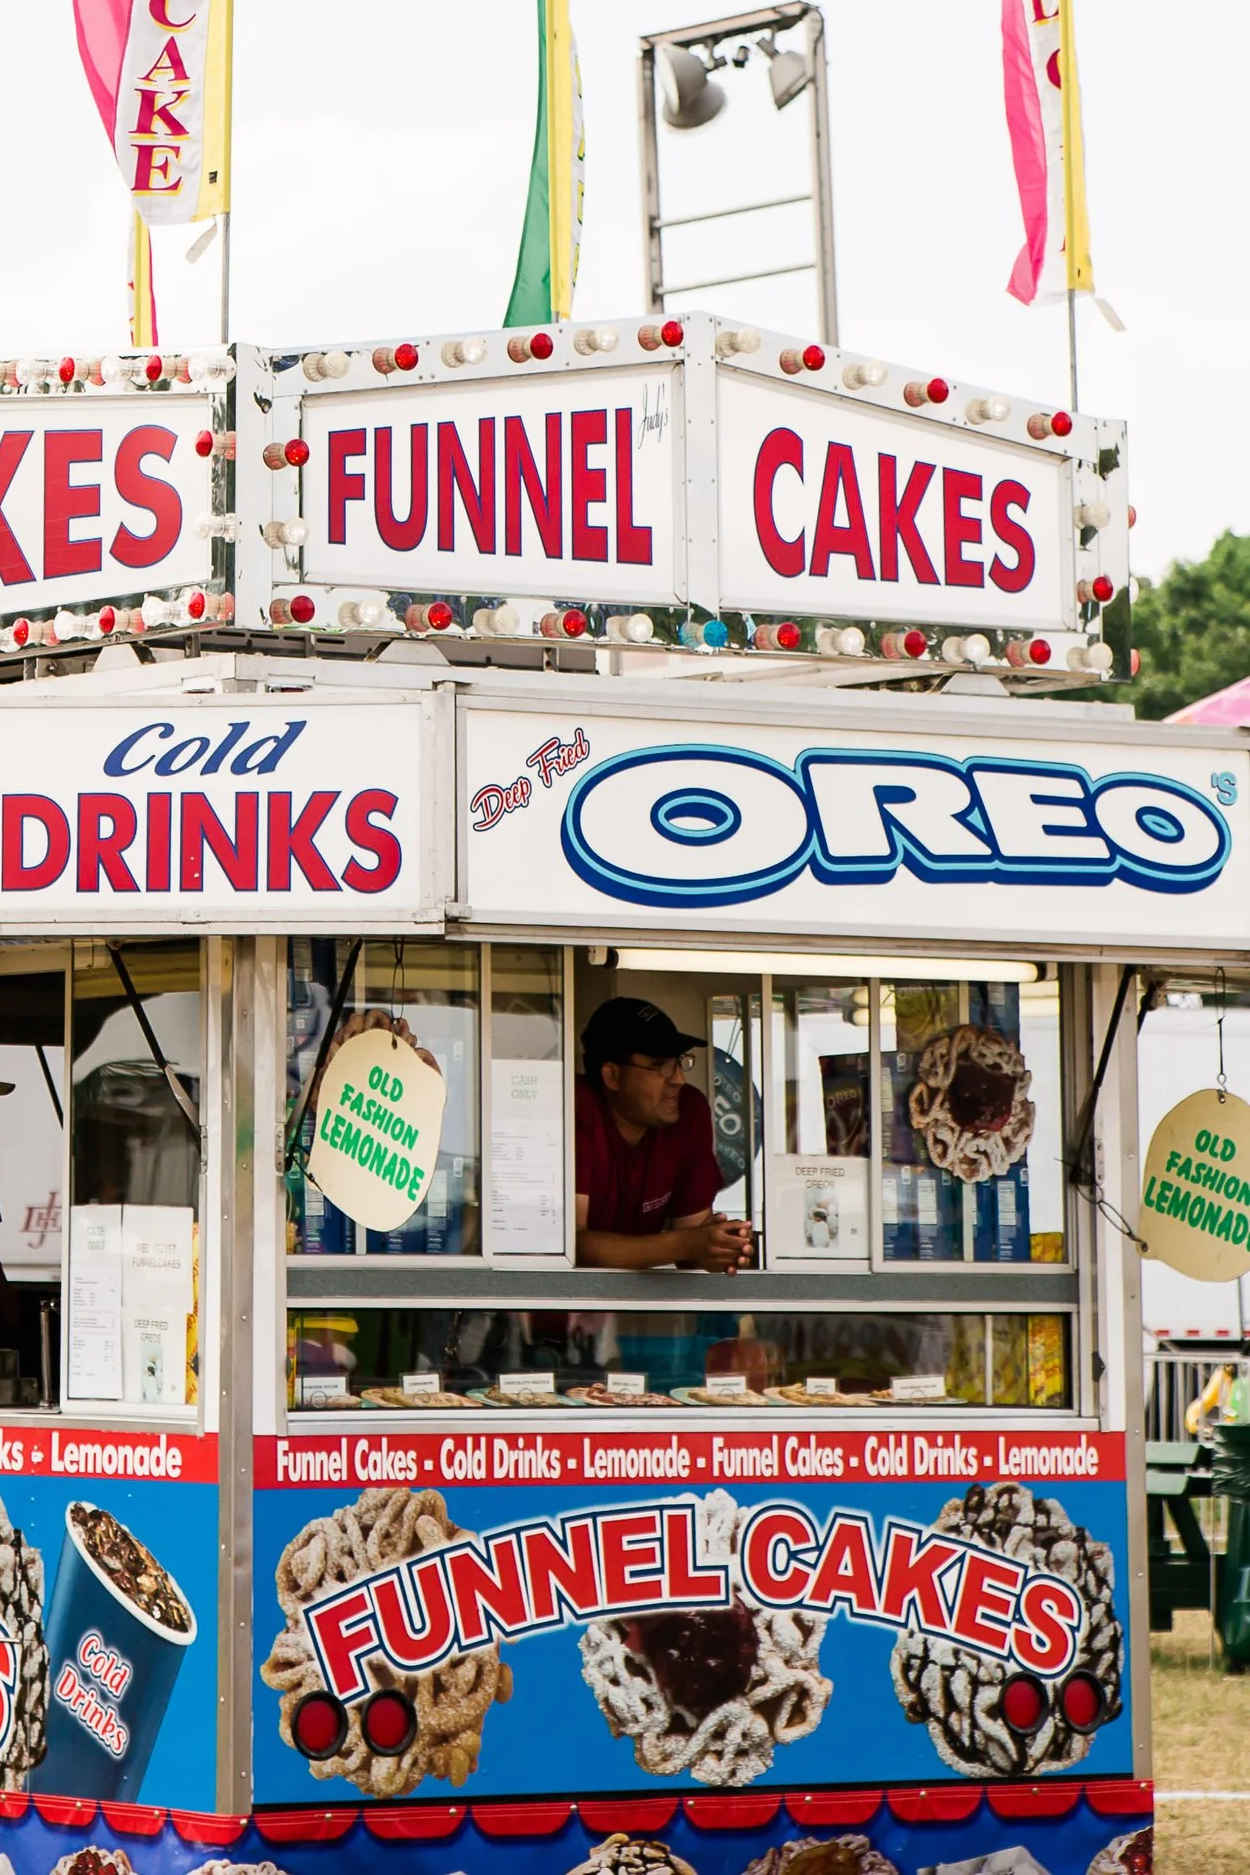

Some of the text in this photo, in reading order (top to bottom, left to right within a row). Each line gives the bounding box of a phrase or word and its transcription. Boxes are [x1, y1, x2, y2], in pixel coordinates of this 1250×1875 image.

[326, 406, 654, 566] FUNNEL
[753, 426, 1036, 593] CAKES
[100, 720, 311, 779] Cold
[470, 727, 590, 832] Deep Fried
[0, 789, 403, 894] DRINKS
[368, 1066, 404, 1102] OLD
[510, 1076, 538, 1086] CASH
[339, 1084, 419, 1151] FASHION
[1195, 1129, 1236, 1162] OLD
[319, 1108, 425, 1201] LEMONADE
[1144, 1176, 1250, 1252] LEMONAD
[51, 1431, 182, 1478] Lemonade
[277, 1434, 1099, 1483] Funnel Cakes Cold Drinks Lemonade Funnel Cakes Cold Drinks Lemonade
[306, 1505, 1079, 1700] FUNNEL CAKES
[80, 1634, 131, 1698] Cold
[56, 1666, 129, 1757] Drinks
